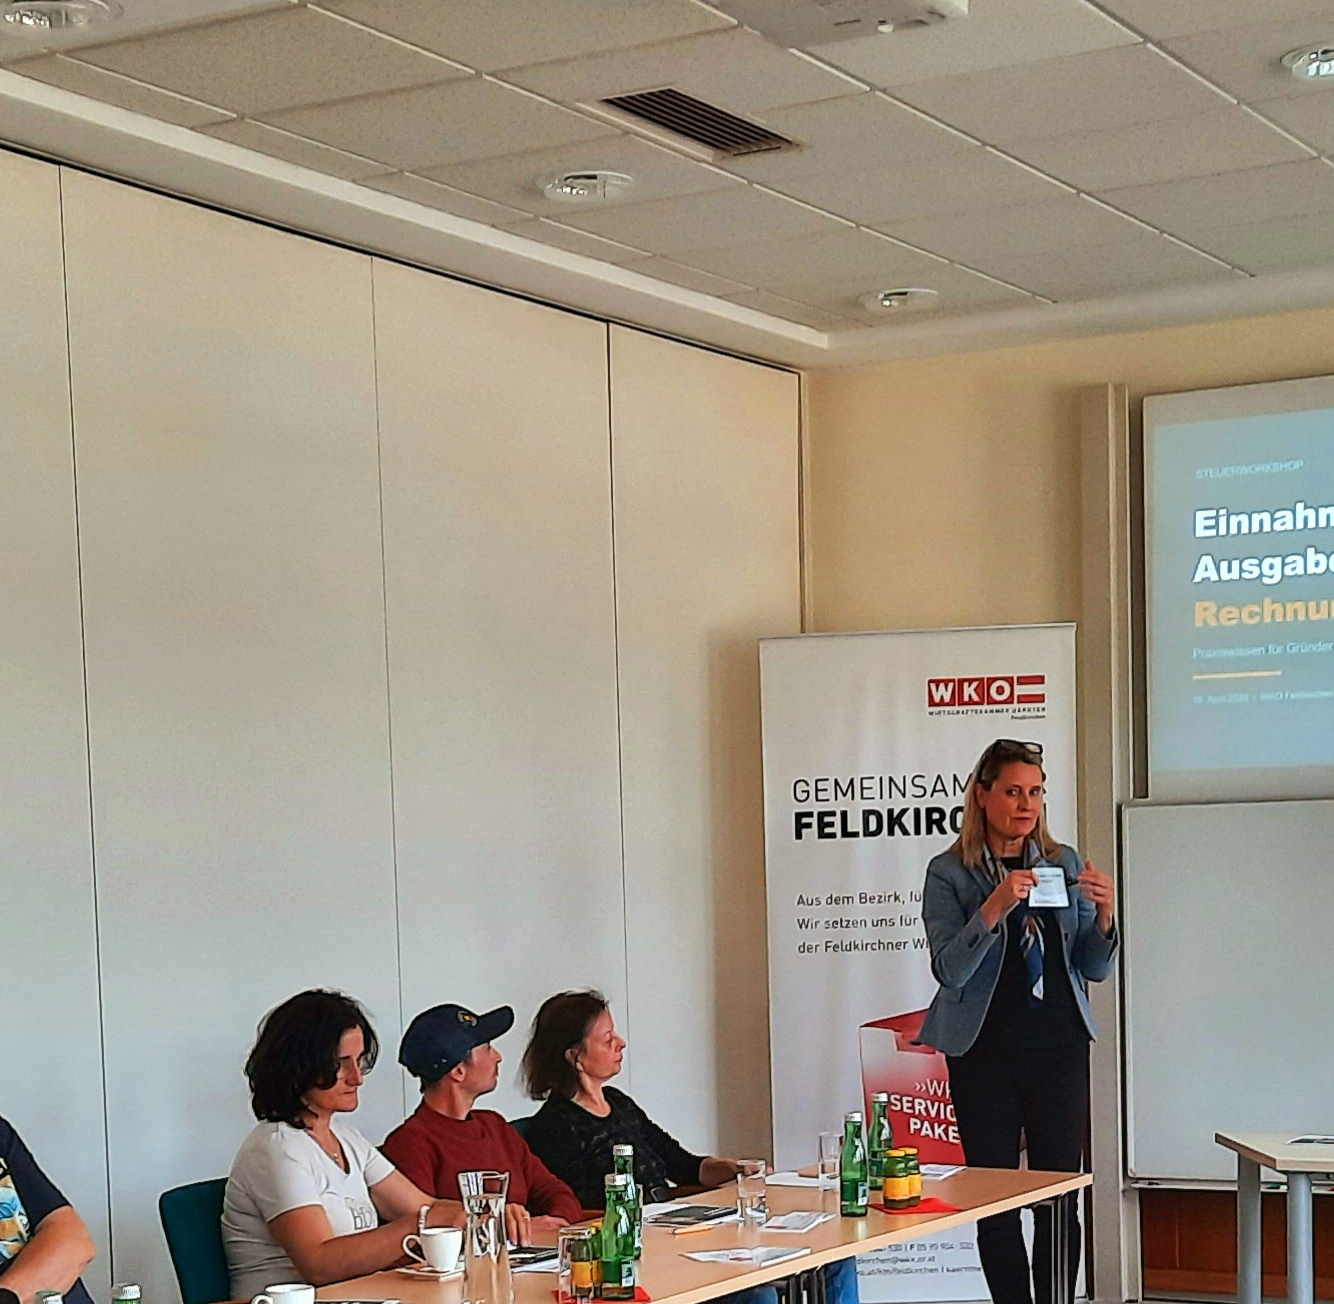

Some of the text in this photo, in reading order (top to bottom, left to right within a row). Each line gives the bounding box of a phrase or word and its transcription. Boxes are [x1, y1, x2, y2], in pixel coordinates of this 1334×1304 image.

[929, 679, 1011, 703] WKO
[792, 772, 973, 803] GEMEINSAM
[796, 893, 821, 907] Aus
[825, 892, 854, 906] dem
[858, 891, 906, 906] Bezirk,
[797, 914, 919, 930] Wir setzen uns für
[797, 941, 819, 954] der
[824, 938, 909, 953] Feldkirchner
